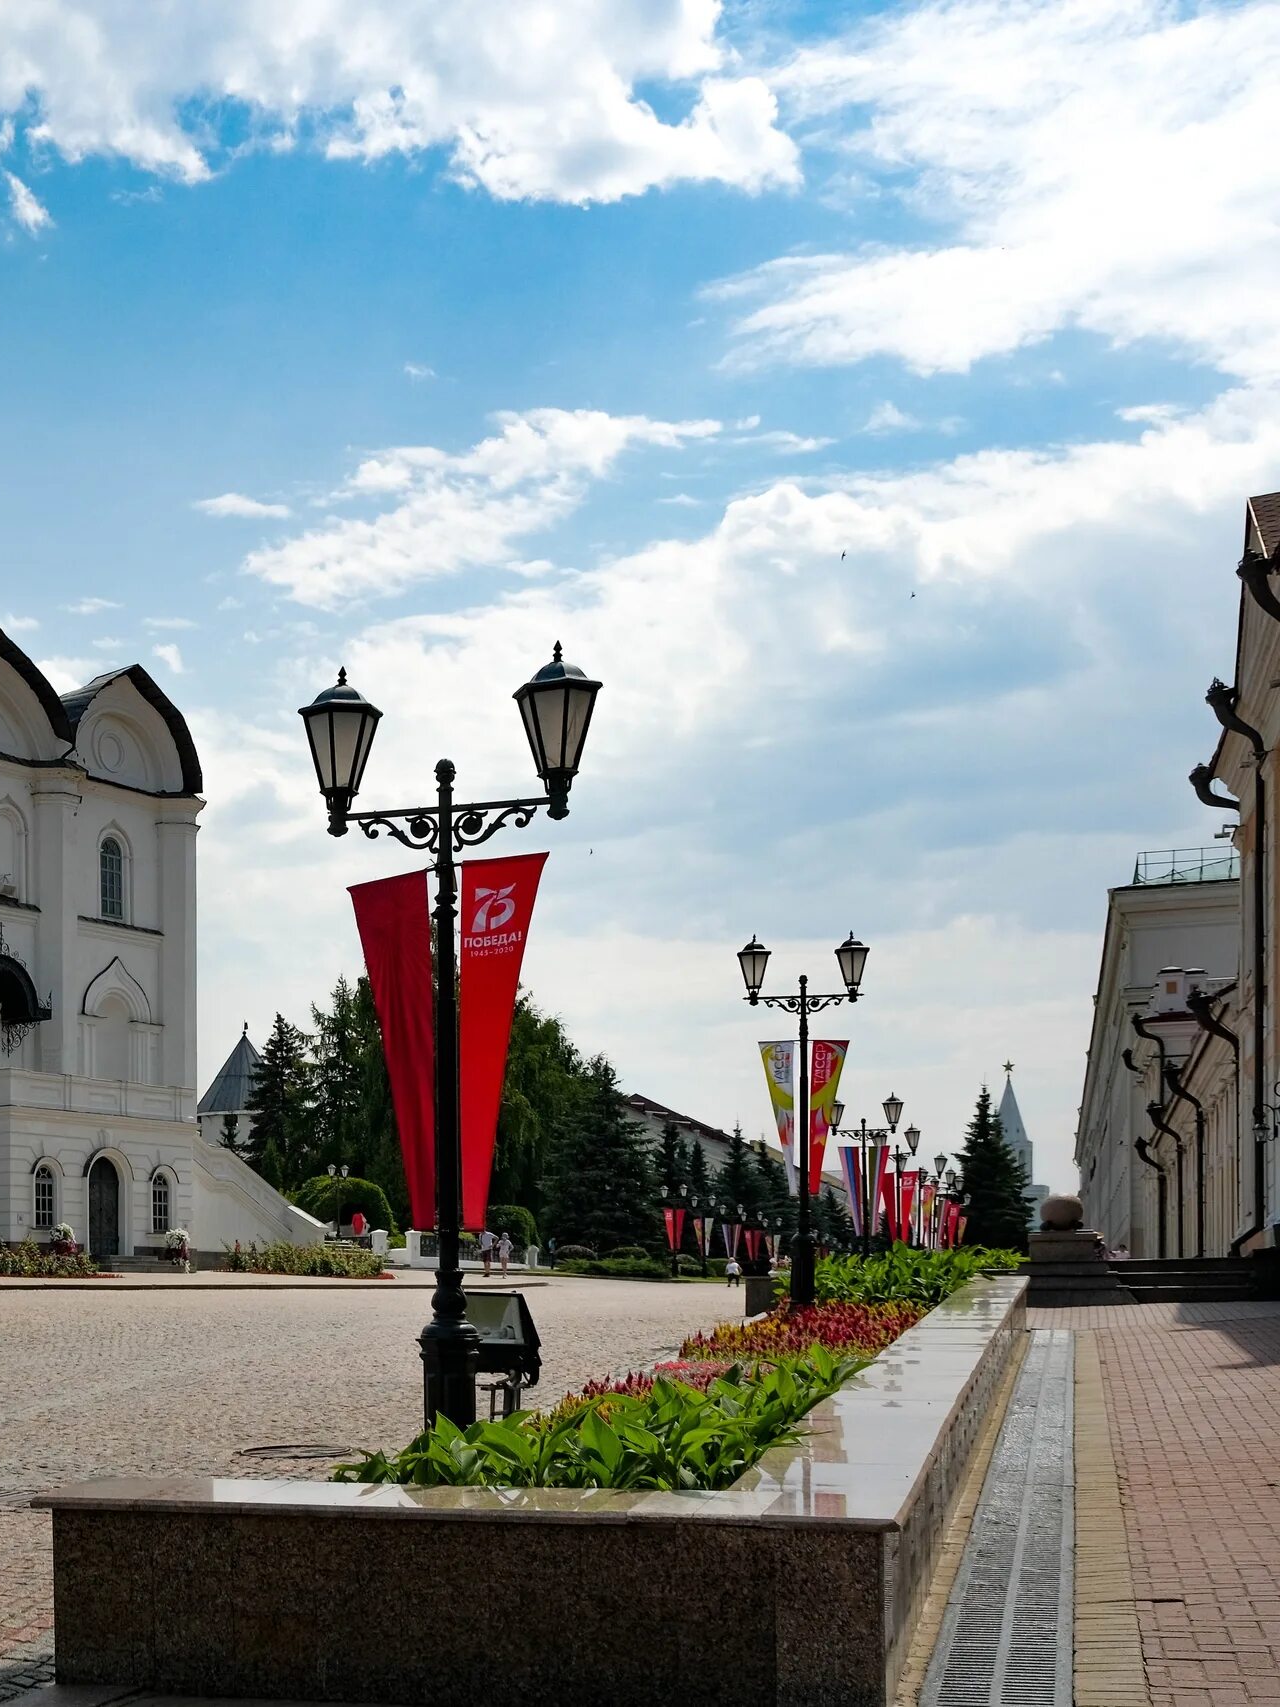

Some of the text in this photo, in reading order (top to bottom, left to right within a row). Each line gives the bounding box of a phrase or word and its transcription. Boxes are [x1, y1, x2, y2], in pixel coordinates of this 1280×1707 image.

[471, 882, 516, 933] 75
[464, 931, 522, 948] ПОБЕДА!
[813, 1044, 827, 1086] ТАССР
